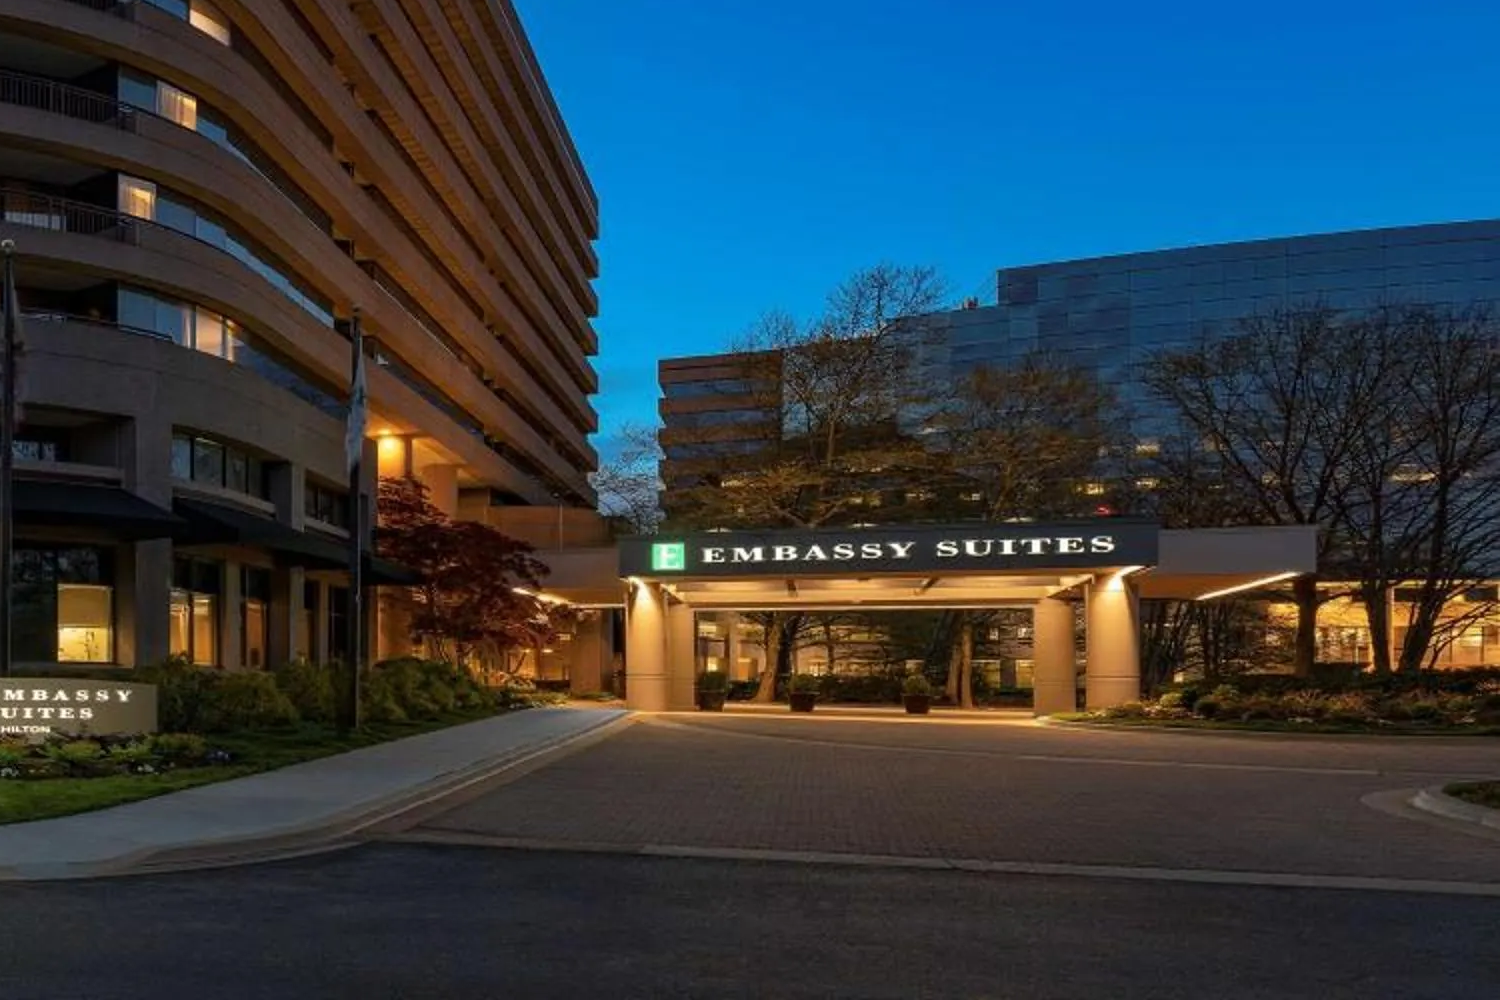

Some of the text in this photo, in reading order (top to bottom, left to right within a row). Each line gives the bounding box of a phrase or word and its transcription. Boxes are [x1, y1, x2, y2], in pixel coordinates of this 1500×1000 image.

[702, 541, 915, 564] EMBASSY
[936, 535, 1116, 557] SUITES
[1, 725, 51, 734] HILTON
